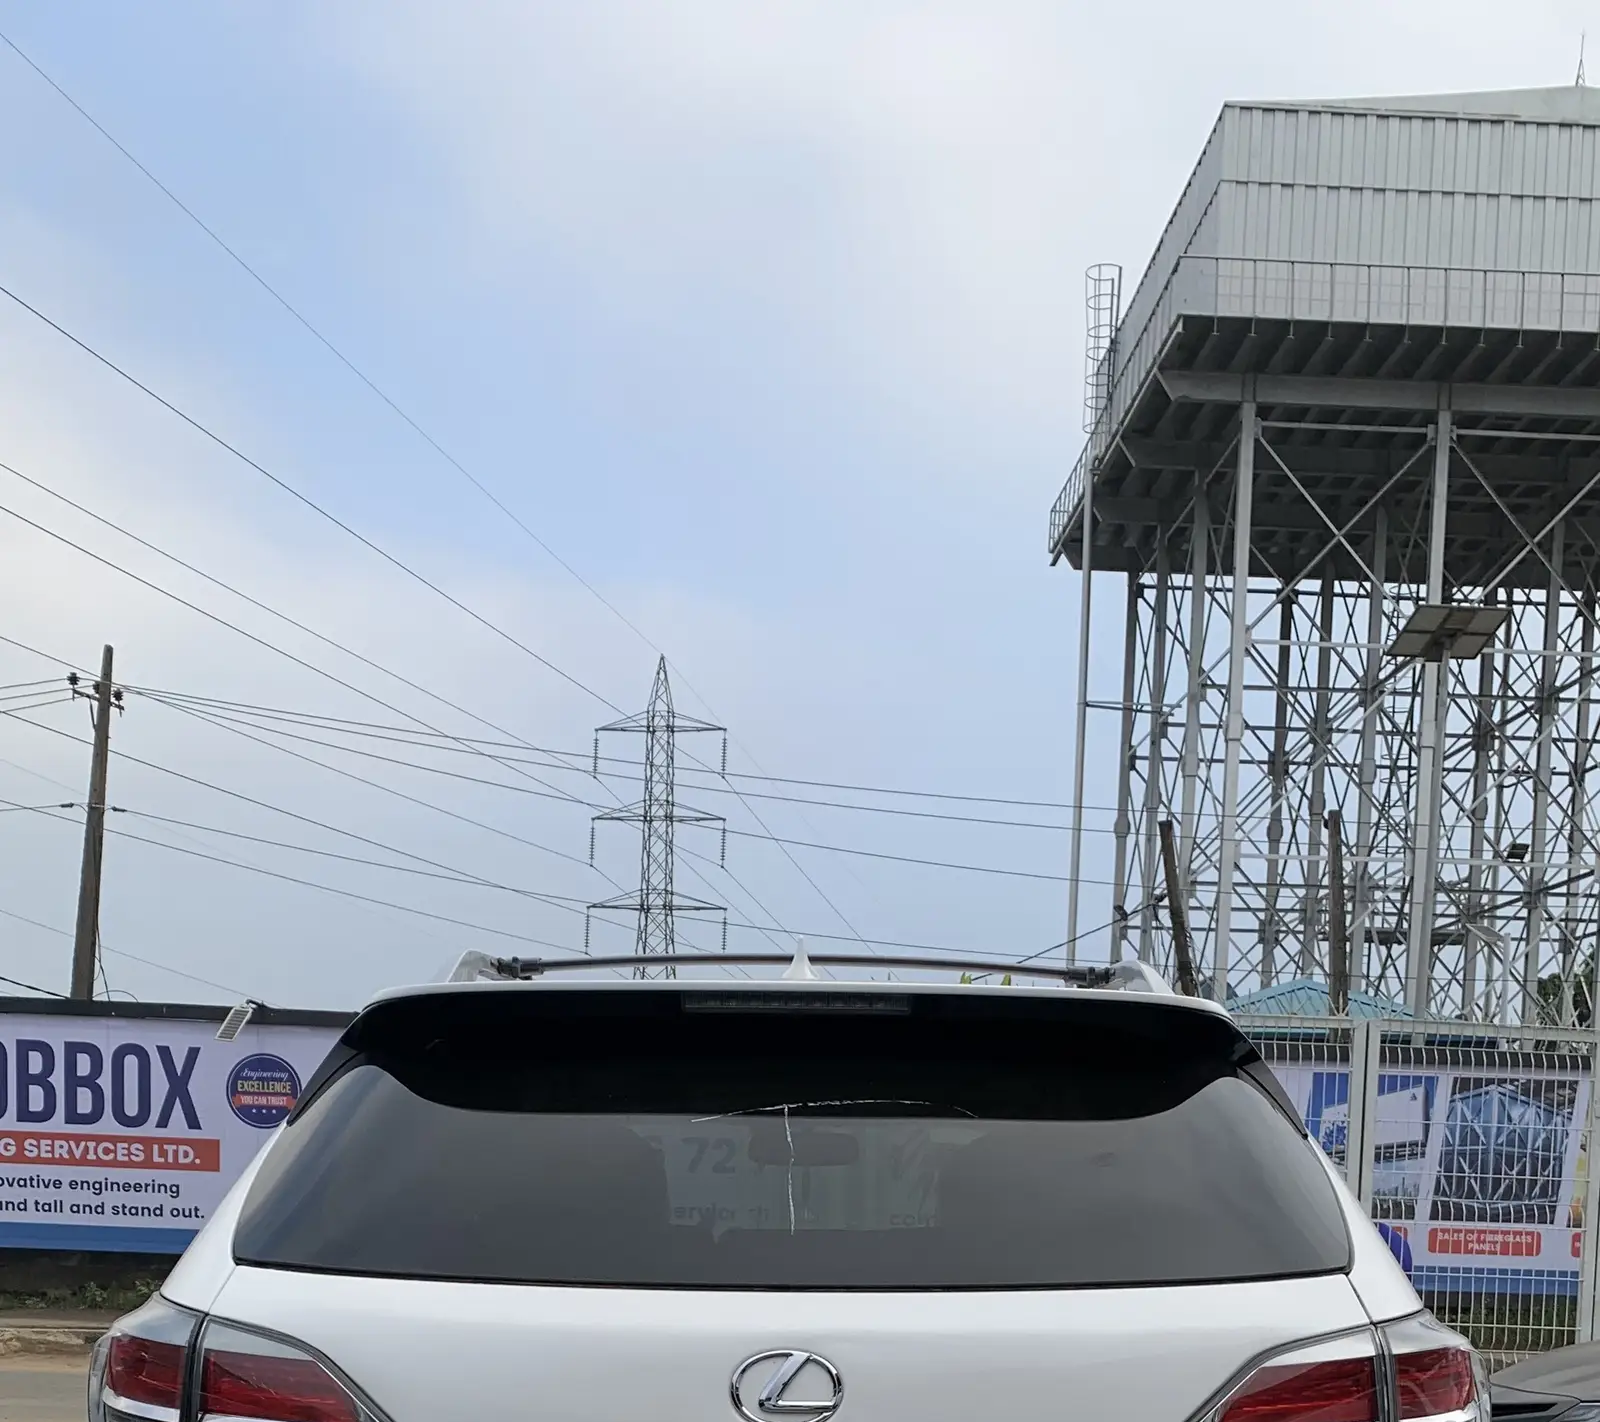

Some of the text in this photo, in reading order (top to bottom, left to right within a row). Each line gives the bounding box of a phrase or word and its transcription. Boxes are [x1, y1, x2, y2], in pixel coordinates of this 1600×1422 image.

[240, 1067, 289, 1082] Engineering
[0, 1038, 203, 1130] BBOX
[237, 1080, 292, 1093] EXCELLENCE
[241, 1095, 288, 1106] YOU CAN TRUST
[24, 1138, 145, 1163] SERVICES
[152, 1143, 201, 1165] LTD.
[68, 1177, 181, 1199] engineering
[34, 1199, 64, 1214] tall
[69, 1201, 105, 1216] and
[111, 1203, 164, 1218] stand
[169, 1205, 205, 1219] out.
[1438, 1231, 1465, 1241] SALES
[1466, 1232, 1479, 1241] OF
[1468, 1242, 1501, 1251] PANELS
